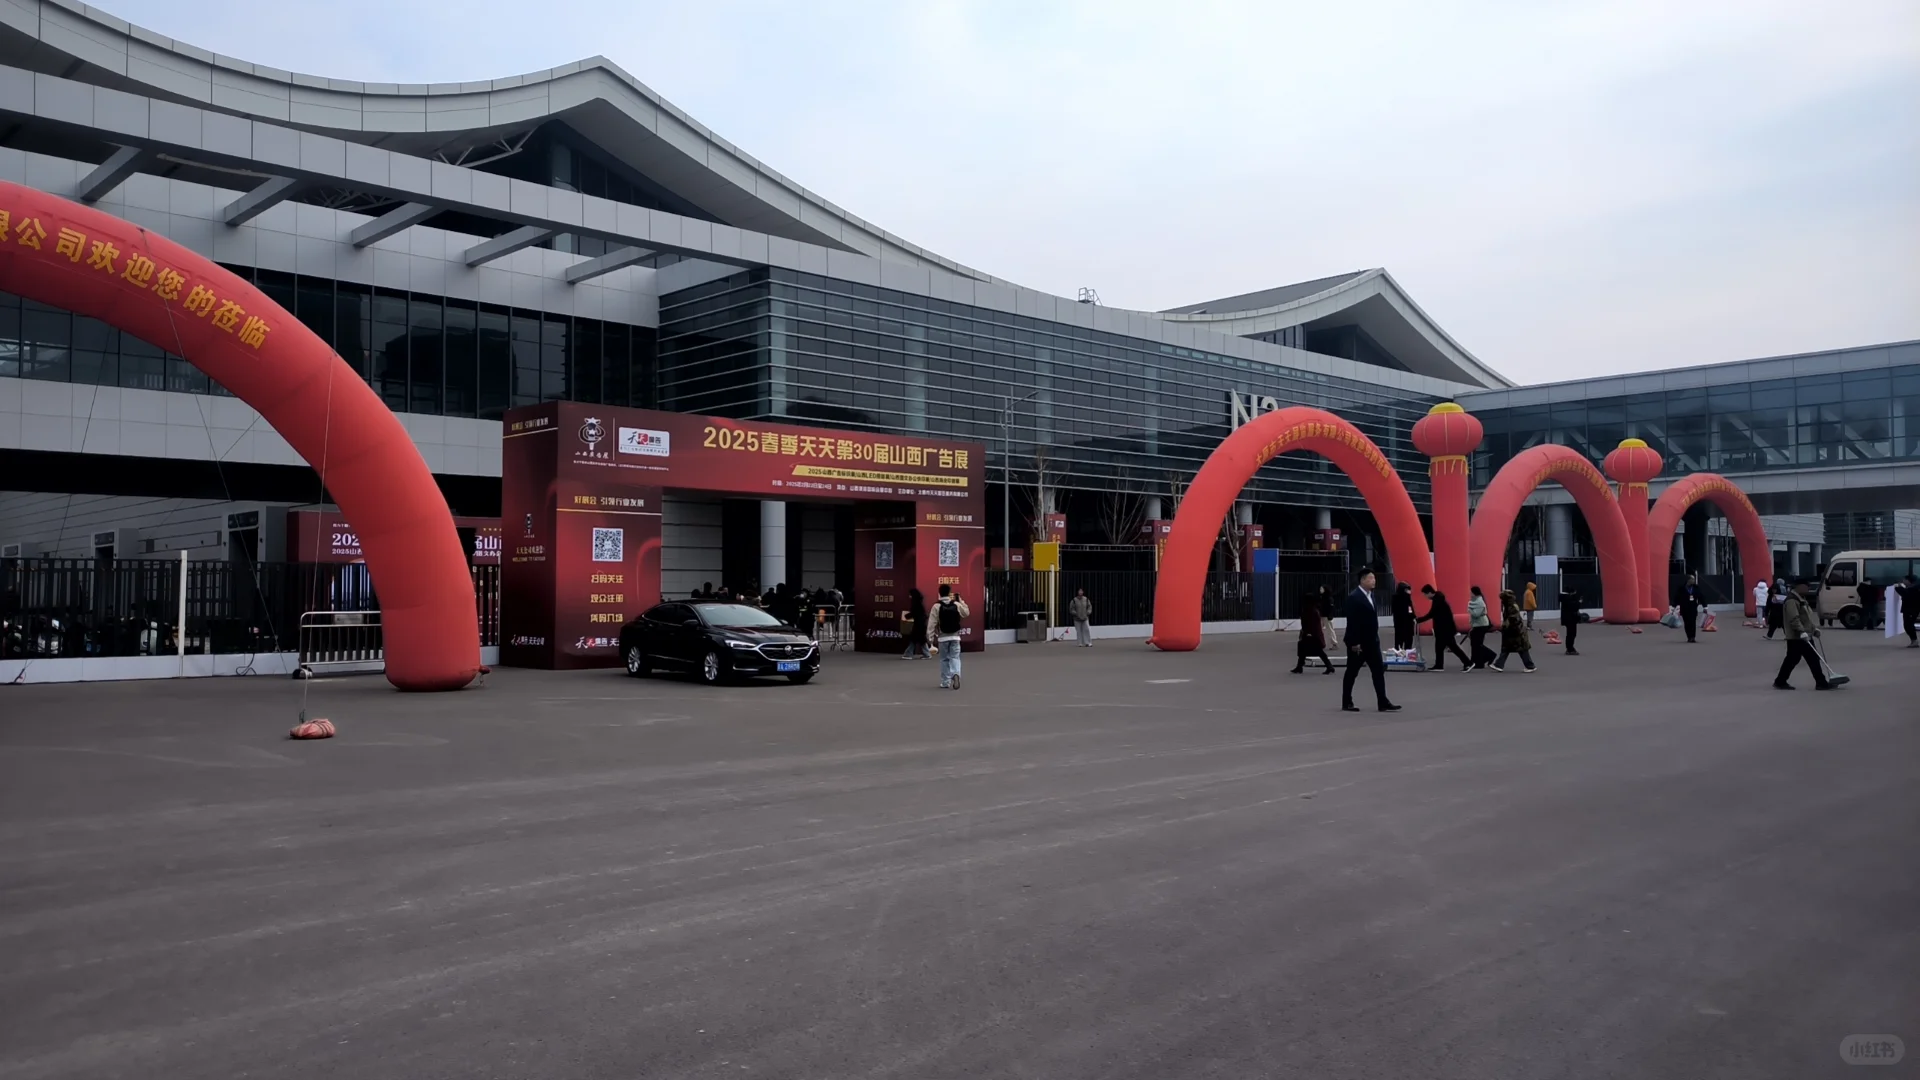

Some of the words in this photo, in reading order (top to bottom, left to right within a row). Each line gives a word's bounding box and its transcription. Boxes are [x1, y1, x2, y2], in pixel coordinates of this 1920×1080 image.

[703, 426, 969, 469] 2025春季天天第30届山西广告展
[591, 574, 624, 584] 扫码关注
[590, 594, 624, 603] 观众注册
